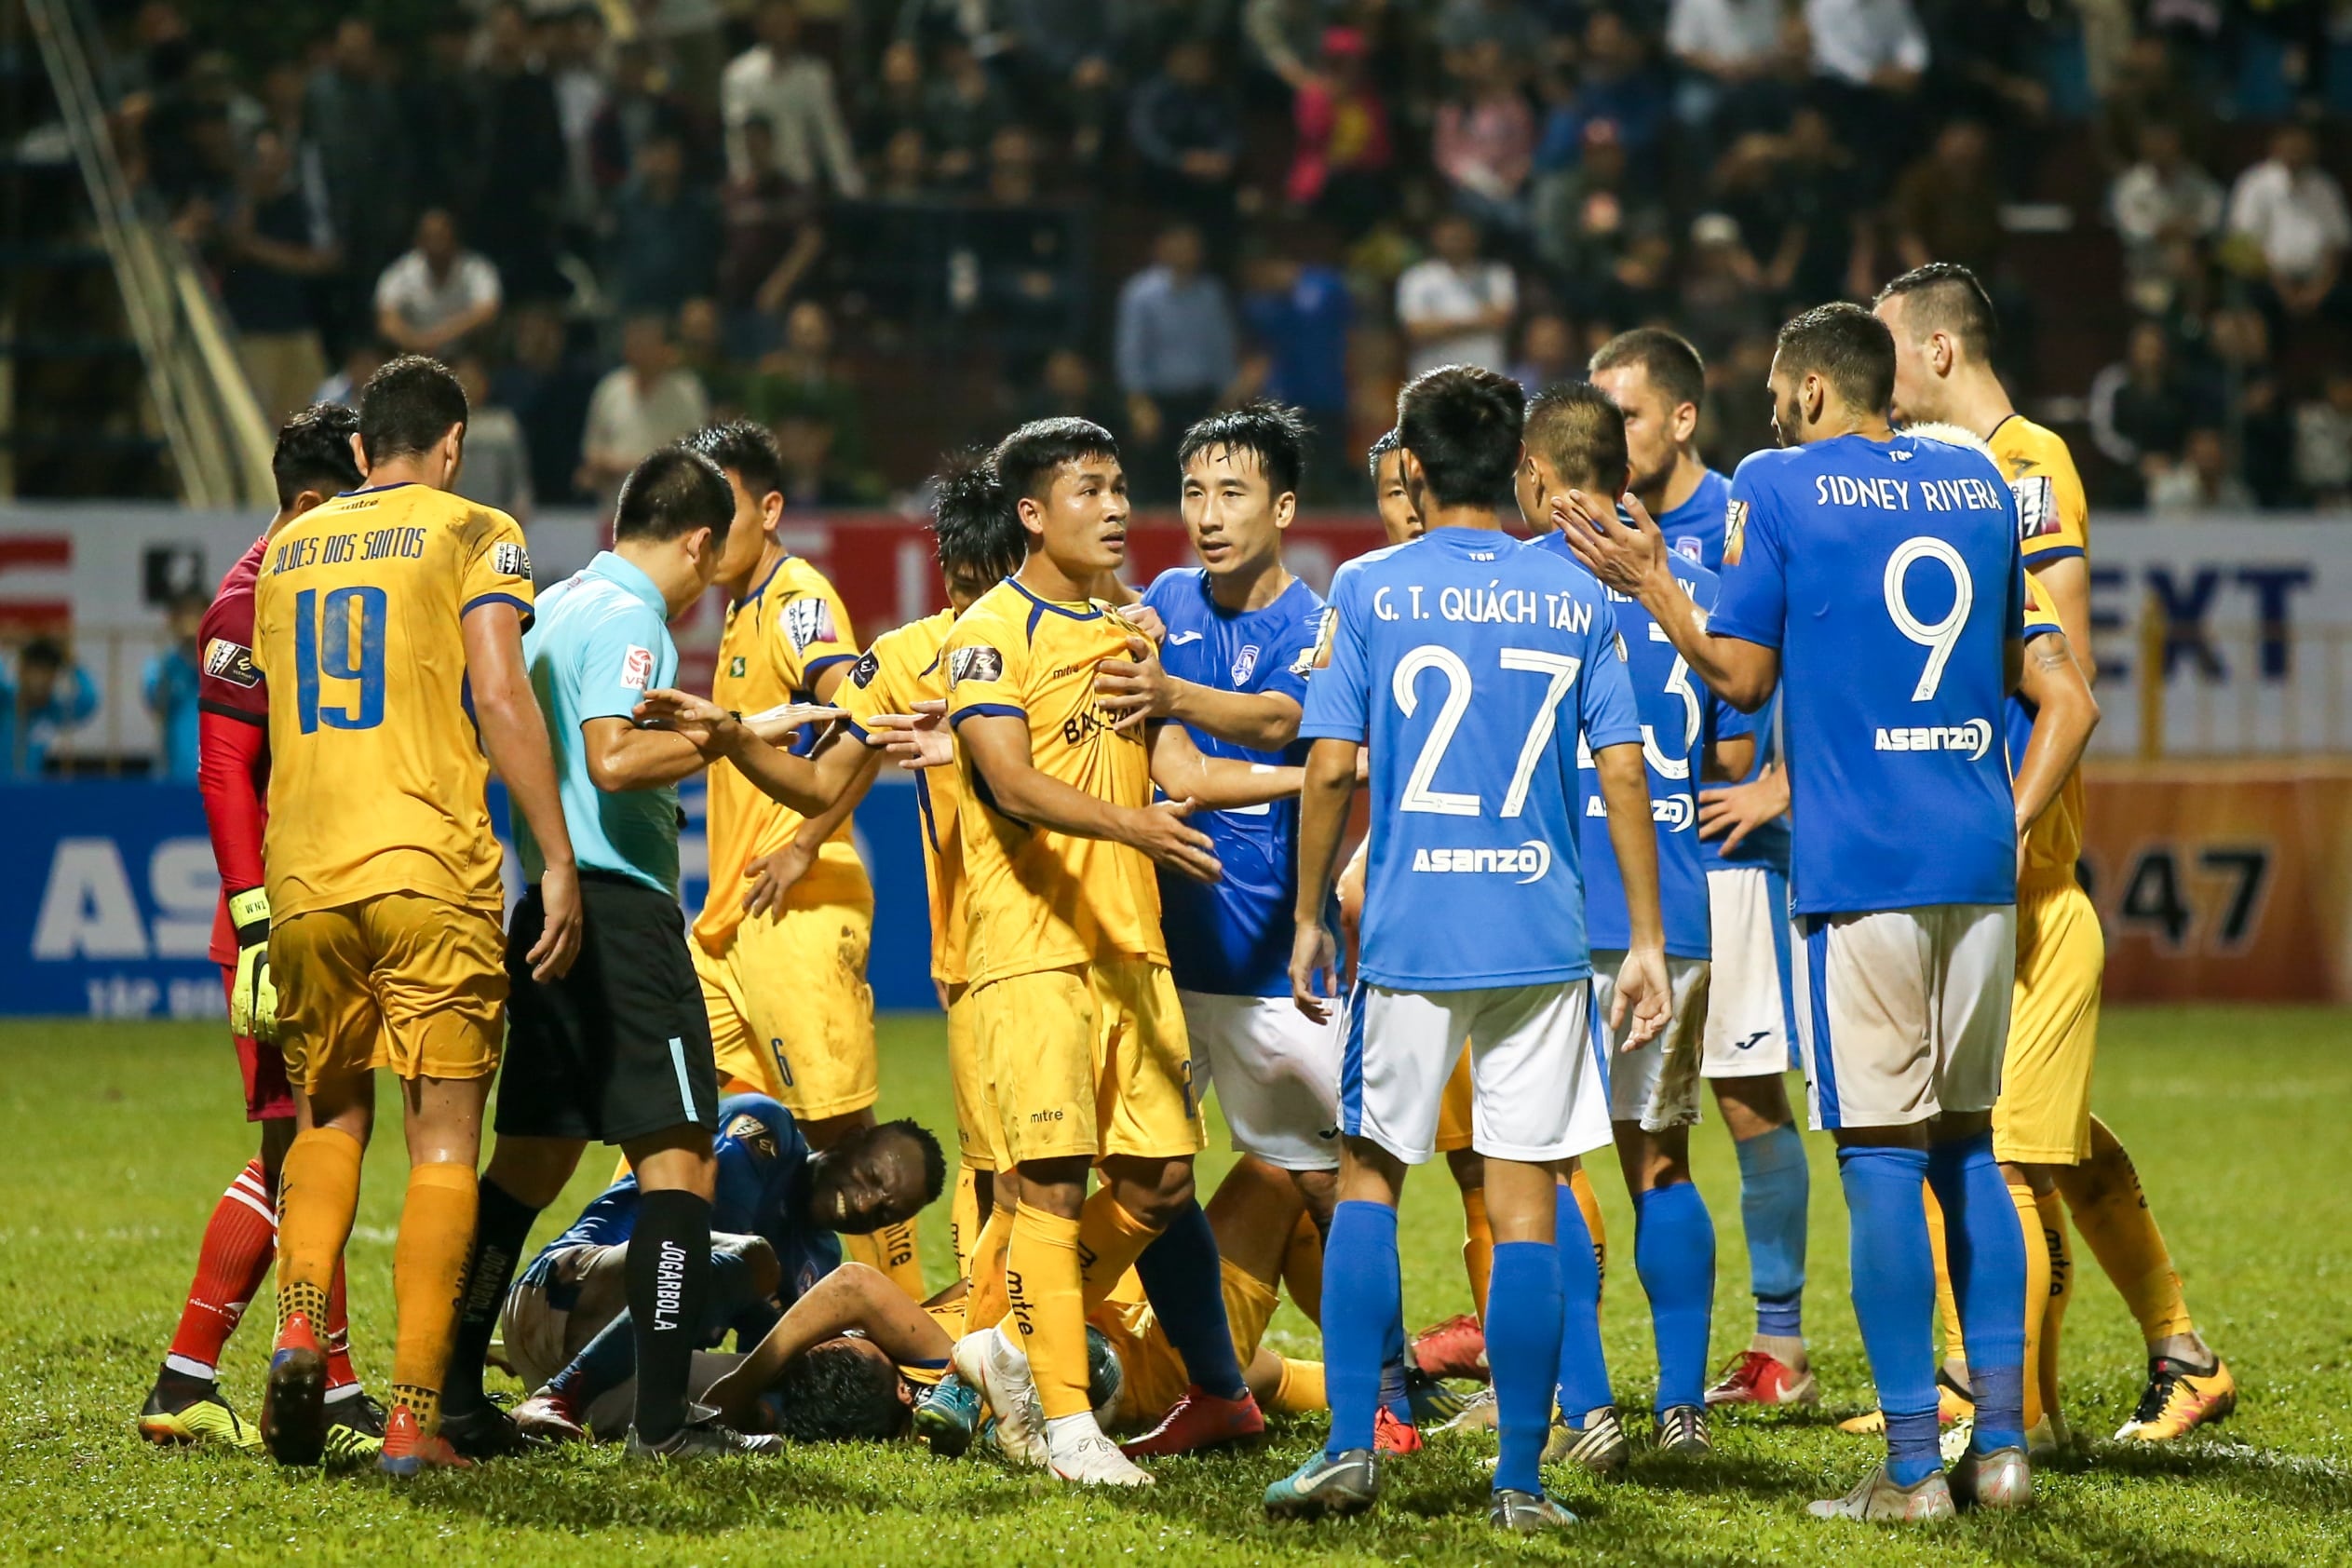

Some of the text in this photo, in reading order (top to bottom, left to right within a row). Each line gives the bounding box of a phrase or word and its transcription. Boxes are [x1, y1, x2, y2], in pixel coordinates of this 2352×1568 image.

[1815, 475, 1909, 510] SIDNEY
[1919, 479, 2002, 511] RIVERA
[322, 534, 358, 562] DOS
[360, 527, 426, 561] SANTOS
[1468, 552, 1495, 562] TQN
[1373, 587, 1399, 621] G.
[1408, 587, 1429, 620] T.
[1440, 579, 1536, 624] QUÁCH
[1545, 590, 1592, 636] TÂN
[1884, 535, 1973, 701] 9
[295, 587, 387, 735] 19
[1053, 664, 1080, 680] mitre
[1391, 644, 1581, 818] 27
[771, 1038, 794, 1087] 6
[1031, 1108, 1064, 1123] mitre
[654, 1240, 687, 1331] JOGARBOLA
[2044, 1228, 2071, 1296] mitre
[1007, 1270, 1034, 1335] mitre
